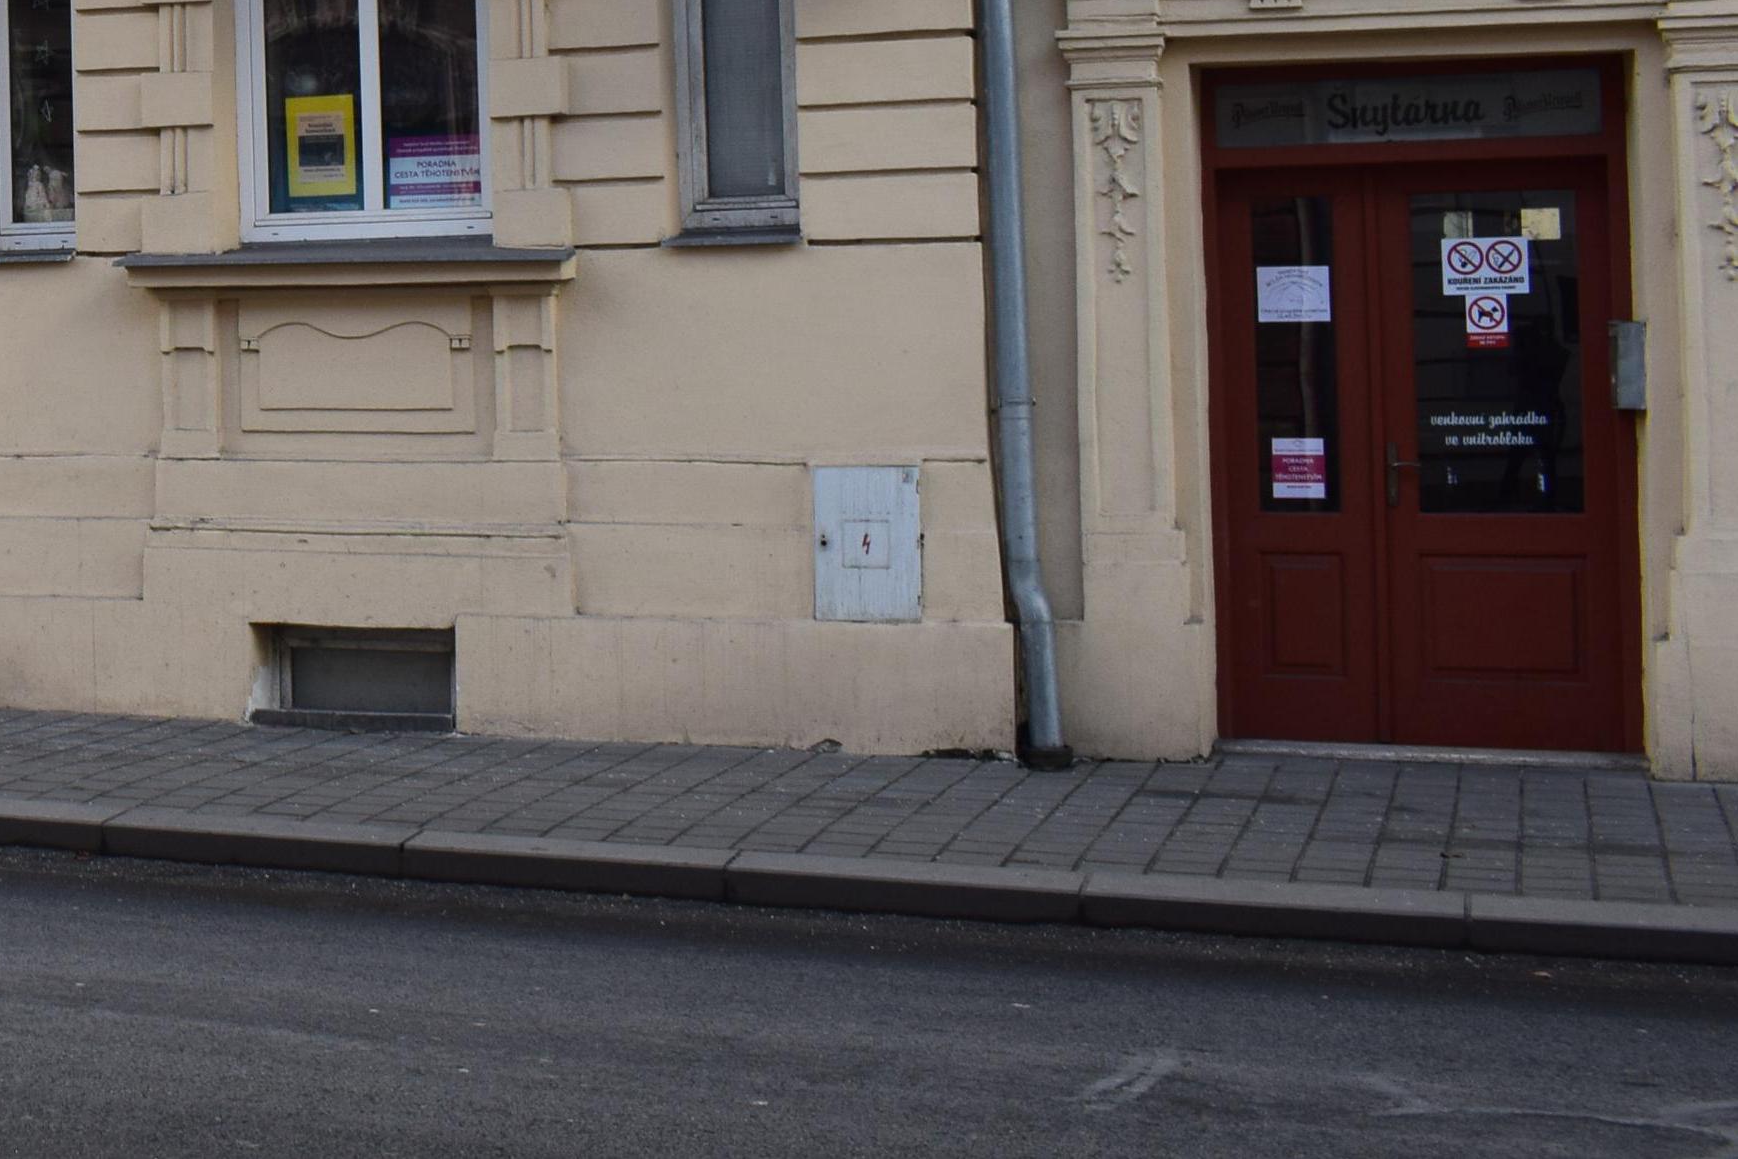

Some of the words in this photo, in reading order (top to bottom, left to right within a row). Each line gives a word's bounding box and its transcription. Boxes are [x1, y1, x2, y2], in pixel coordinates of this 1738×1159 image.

[1326, 85, 1486, 136] Šnytárna
[394, 170, 419, 179] CESTA
[1448, 276, 1481, 285] KOUŘENÍ
[1445, 435, 1459, 446] ve
[1463, 431, 1534, 446] vnitrobloku
